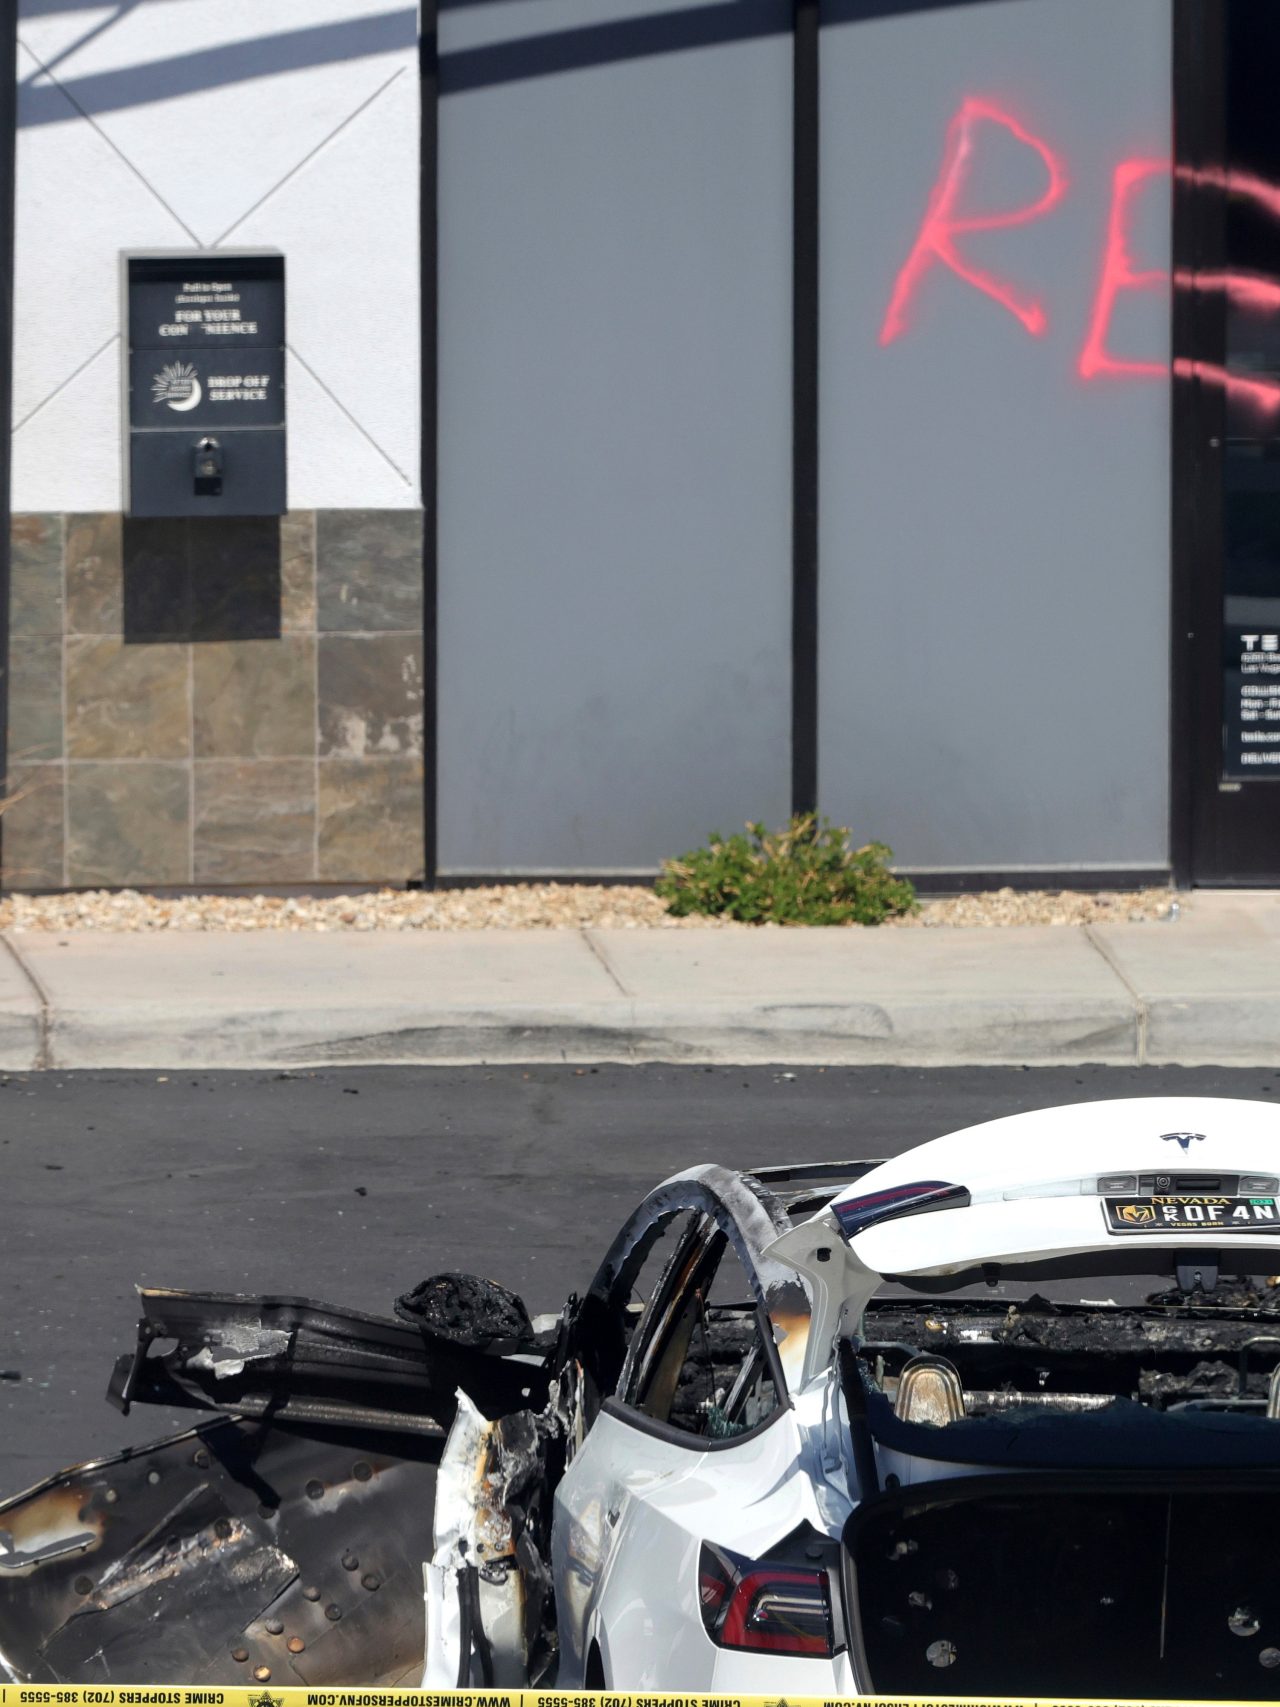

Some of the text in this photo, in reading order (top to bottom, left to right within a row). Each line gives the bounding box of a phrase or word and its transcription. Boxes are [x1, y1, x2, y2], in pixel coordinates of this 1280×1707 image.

[175, 309, 241, 322] FOR YOUR
[207, 375, 270, 388] DROP OFF
[208, 388, 267, 401] SERVICE
[1150, 1197, 1233, 1205] NEVADA
[20, 1690, 224, 1704] CRIME STOPPERS (702) 385-5555
[307, 1695, 510, 1707] WWW.CRIMESTOPPERSOFNV.COM
[537, 1696, 595, 1707] 385-5555
